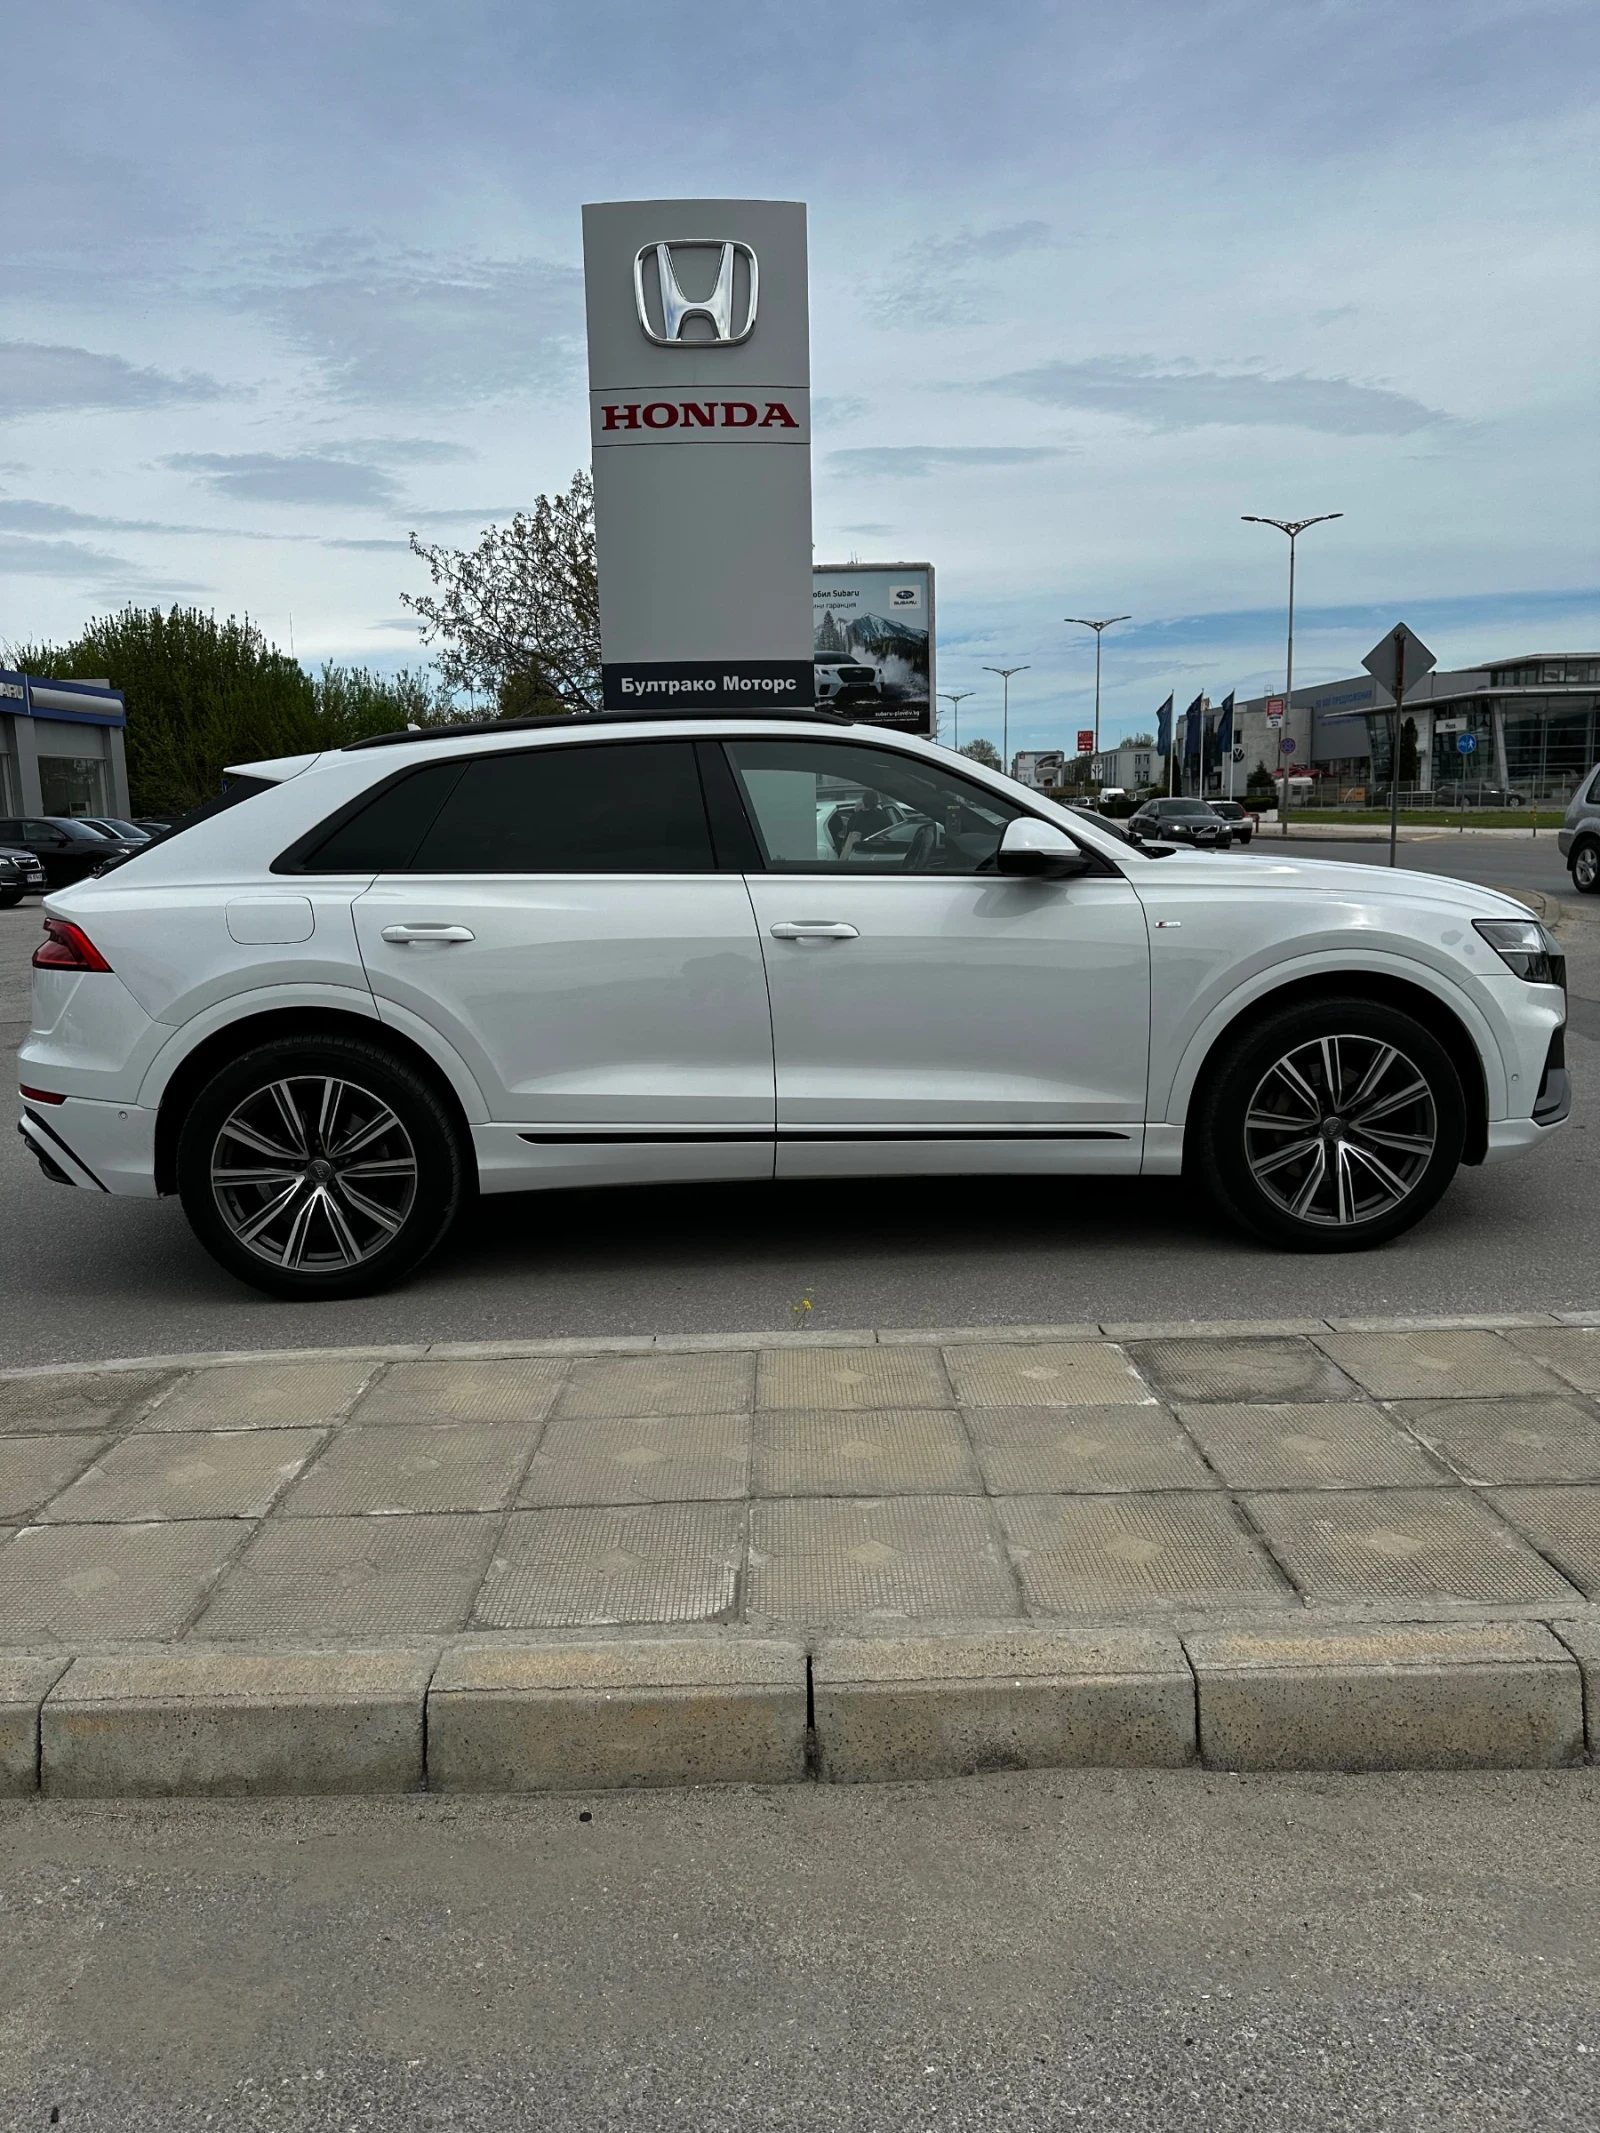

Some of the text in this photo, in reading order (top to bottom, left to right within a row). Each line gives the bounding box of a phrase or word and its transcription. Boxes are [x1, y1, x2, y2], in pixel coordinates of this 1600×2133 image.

[601, 402, 799, 430] HONDA
[832, 589, 860, 597] Subaru
[826, 602, 857, 610] гаранция
[621, 676, 797, 696] Бултрако Моторс
